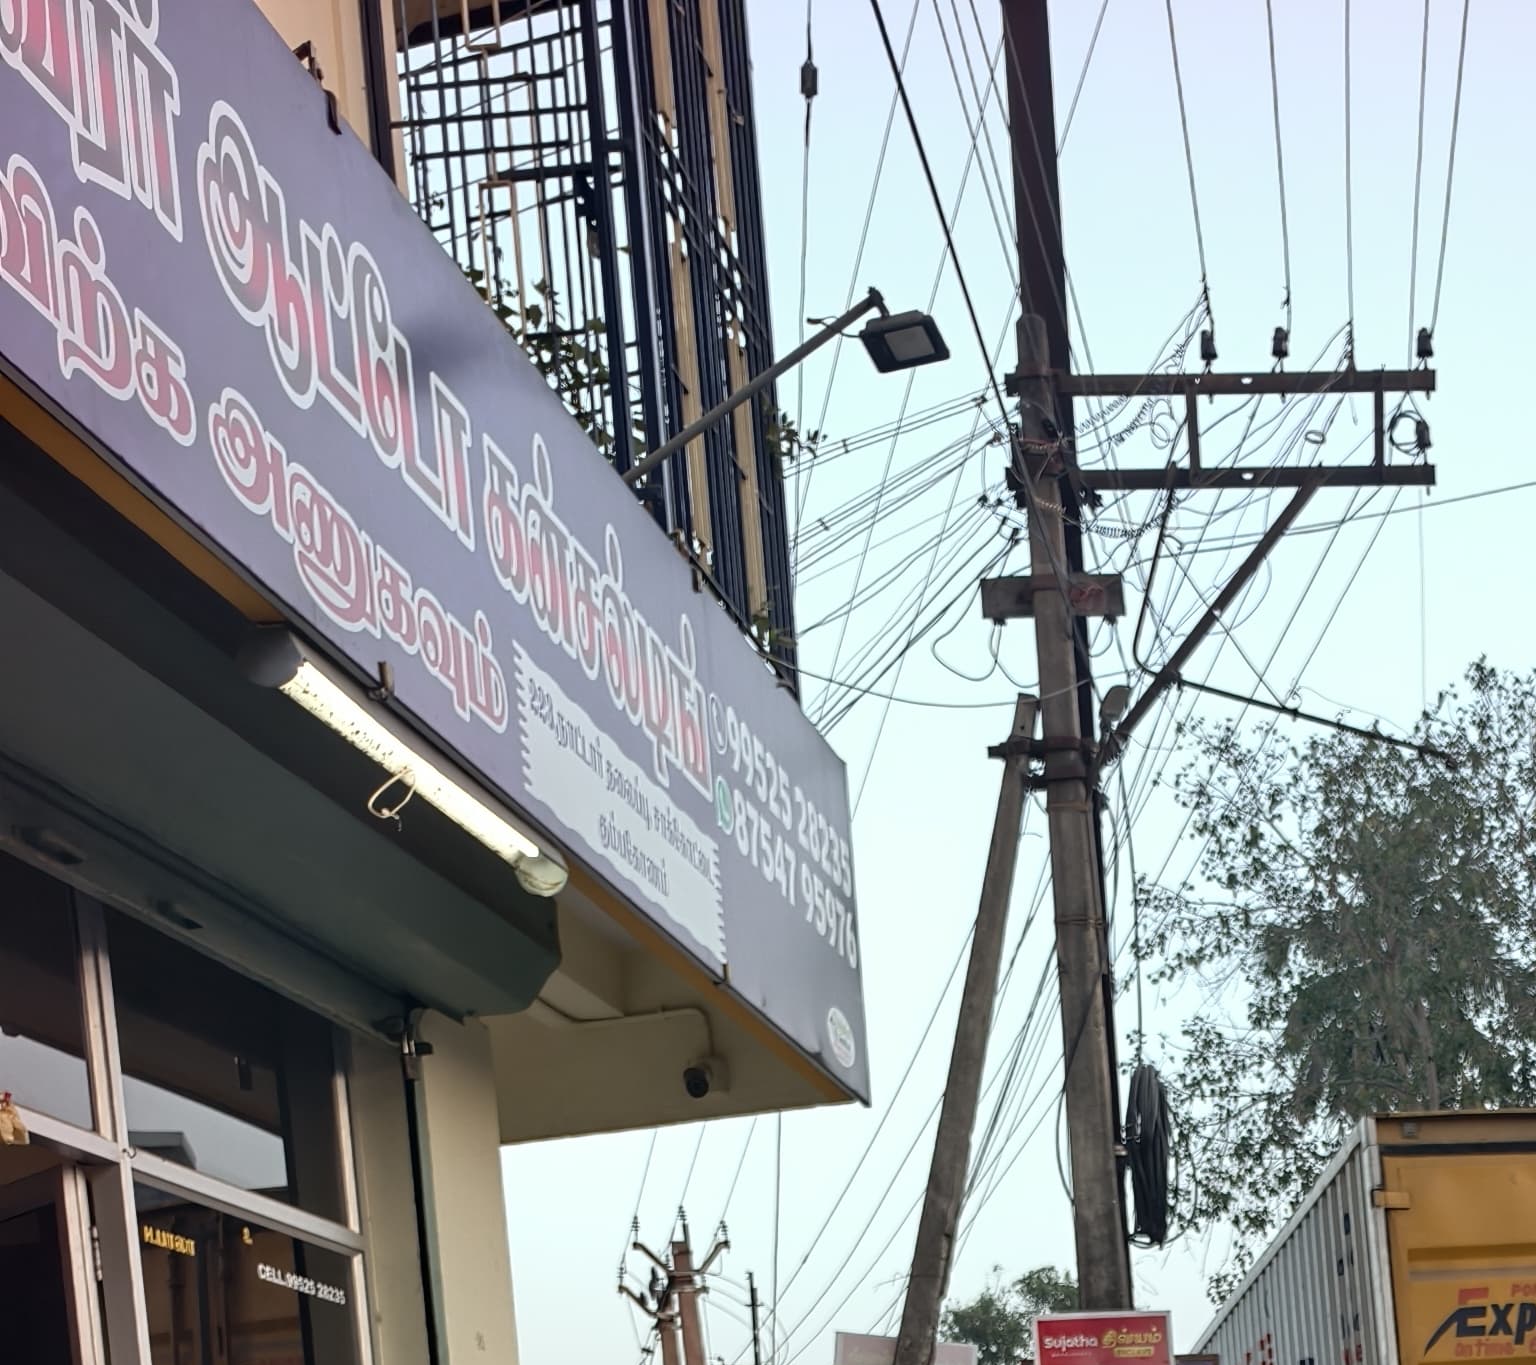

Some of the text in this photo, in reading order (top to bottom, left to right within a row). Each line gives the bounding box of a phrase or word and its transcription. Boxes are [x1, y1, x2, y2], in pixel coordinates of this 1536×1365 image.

[197, 100, 475, 552] ஆட்டோ
[482, 432, 714, 802] கன்சல்டிங்
[208, 387, 508, 733] அணுகவும்
[726, 705, 851, 898] 99525 28235
[733, 789, 797, 907] 87547
[801, 863, 857, 968] 95976
[1044, 1334, 1098, 1352] Sujatha
